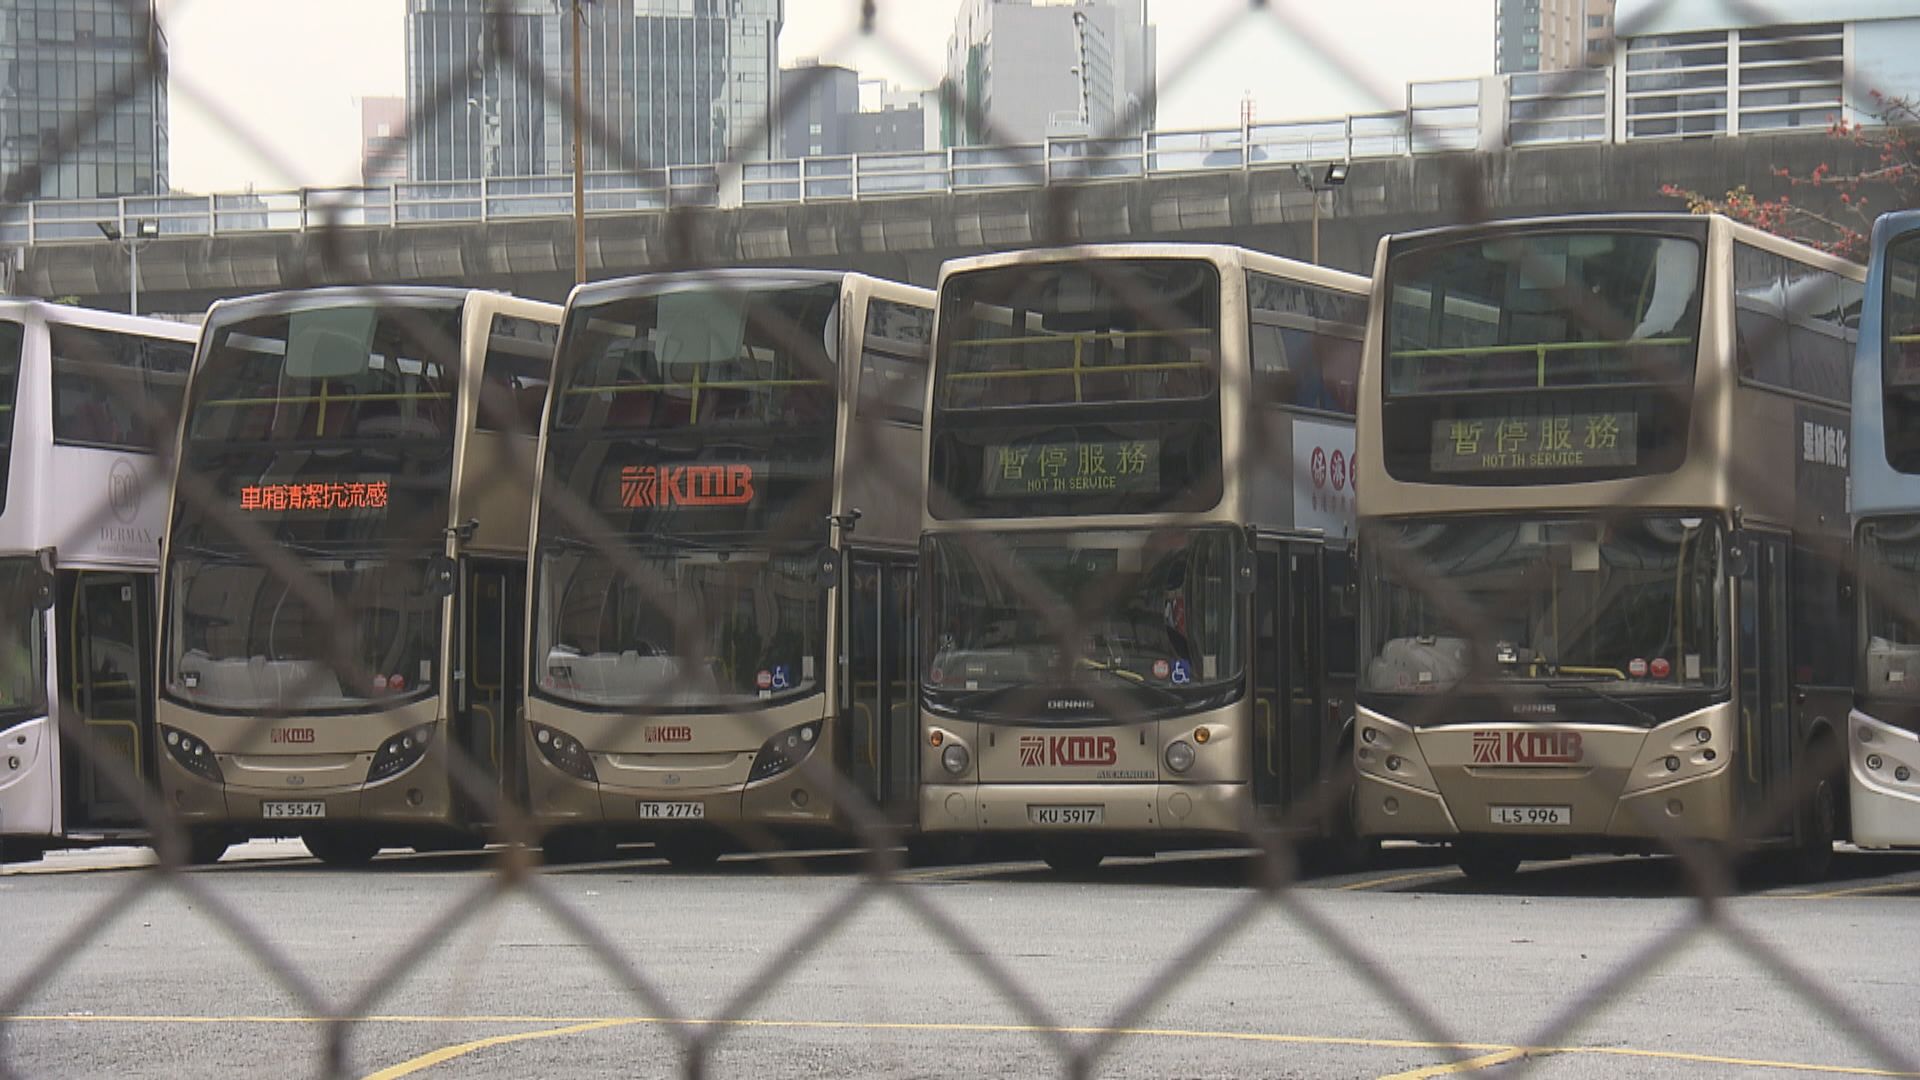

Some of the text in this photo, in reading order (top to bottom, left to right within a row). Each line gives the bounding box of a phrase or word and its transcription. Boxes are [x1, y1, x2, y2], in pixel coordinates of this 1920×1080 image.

[1450, 415, 1620, 456] 暫停服務
[999, 443, 1148, 479] 暫停服務
[1483, 452, 1584, 468] NOT IN SERVICE
[660, 464, 754, 505] KMB
[1027, 476, 1117, 492] NOT IN SERVICE
[240, 480, 388, 511] 車廂清潔抗流感
[100, 527, 151, 543] DERMAX
[1047, 700, 1095, 709] DENNIS
[1508, 703, 1557, 713] ENNIS
[283, 728, 315, 743] KMB
[658, 726, 692, 743] KMB
[1050, 736, 1117, 766] KMB
[1507, 731, 1584, 763] KMB
[266, 804, 321, 816] TS 5547
[643, 804, 701, 817] TR 2776
[1039, 810, 1096, 823] KU 5917
[1502, 809, 1558, 823] LS 996
